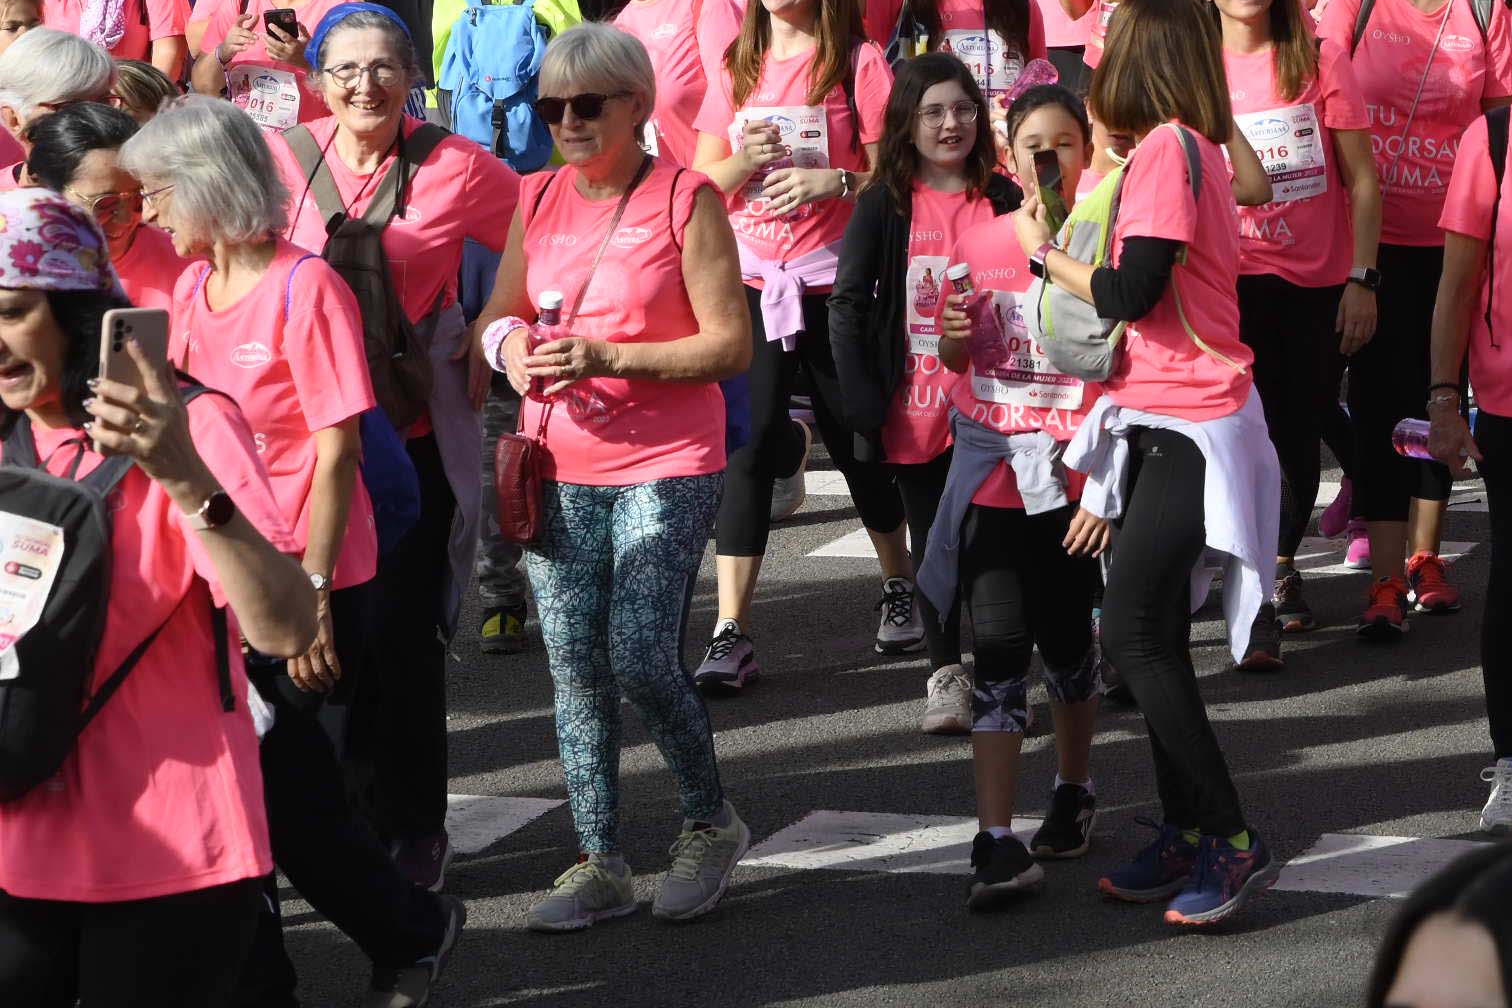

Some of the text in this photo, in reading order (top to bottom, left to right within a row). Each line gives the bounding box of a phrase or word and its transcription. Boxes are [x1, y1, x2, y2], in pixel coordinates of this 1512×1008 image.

[249, 98, 274, 113] 016
[1366, 103, 1397, 126] TU
[1370, 134, 1460, 160] DORSA
[1009, 358, 1041, 370] 21381
[1032, 375, 1057, 383] MUJER
[970, 402, 1081, 431] DORSAL
[13, 539, 50, 558] SUMA
